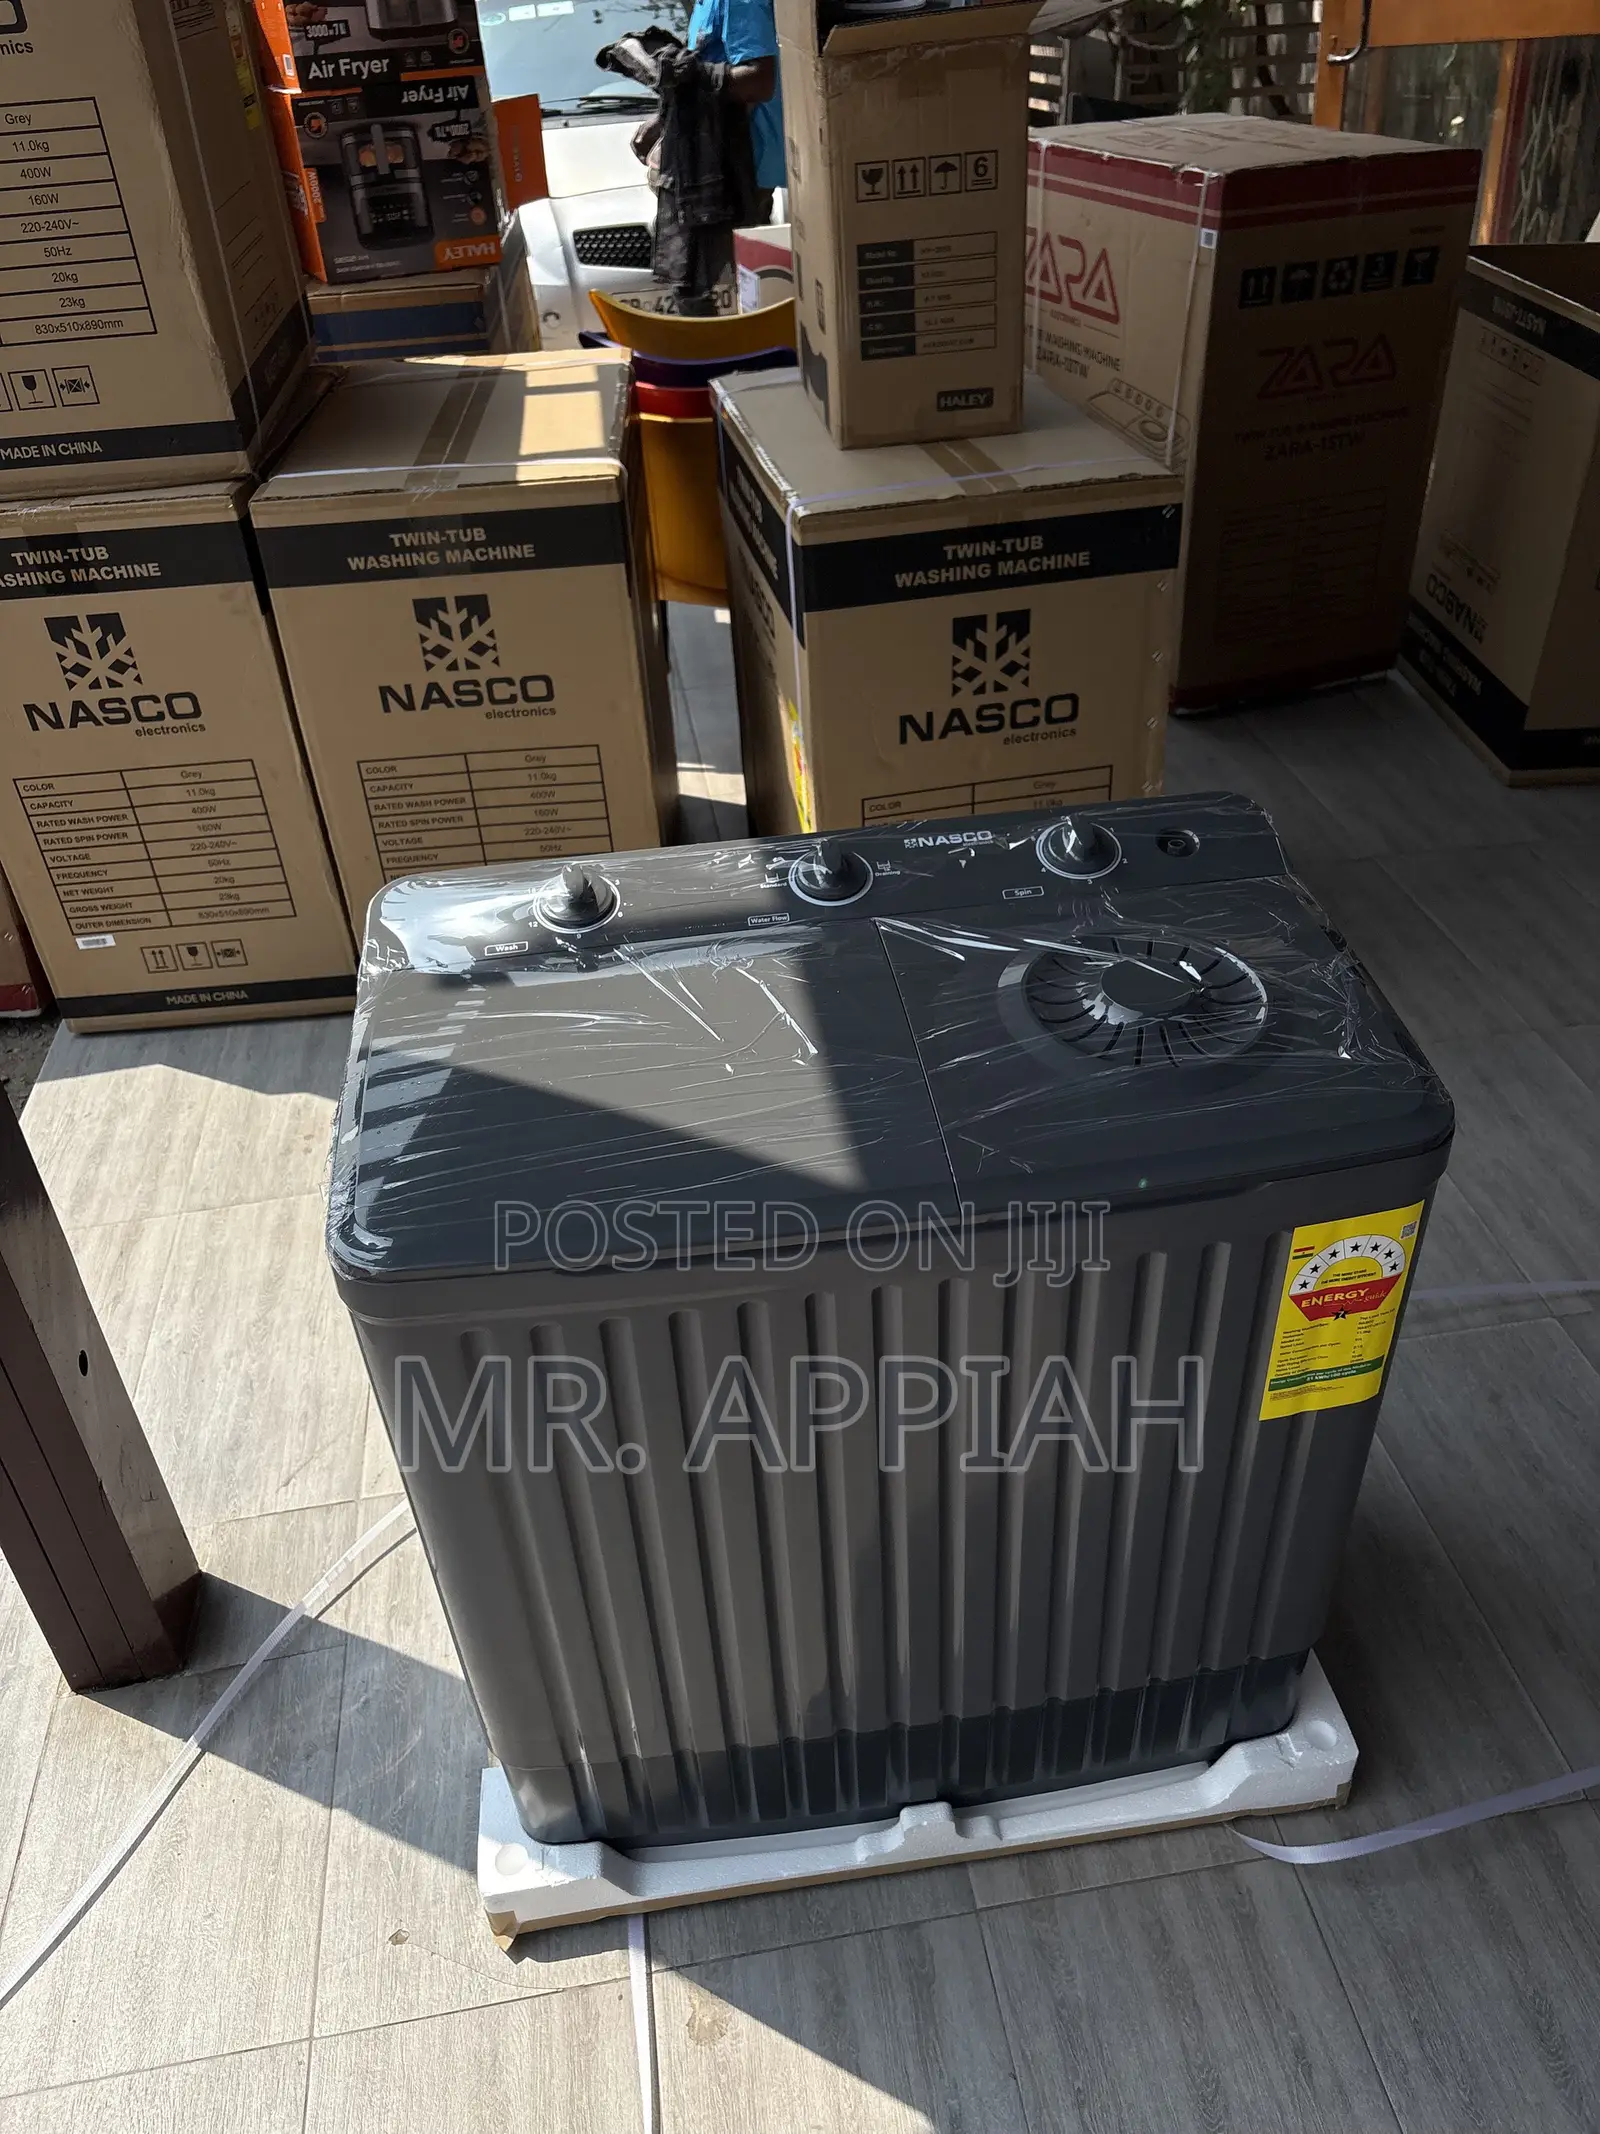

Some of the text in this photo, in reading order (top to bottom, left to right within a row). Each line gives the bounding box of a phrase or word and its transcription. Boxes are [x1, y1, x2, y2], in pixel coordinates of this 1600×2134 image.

[308, 58, 390, 80] Air Fryer
[402, 84, 469, 104] Air Fryer
[4, 113, 32, 126] Grey
[12, 139, 50, 153] 11.0kg
[20, 166, 52, 179] 400W
[974, 156, 988, 178] 6
[28, 193, 59, 206] 160W
[20, 219, 80, 233] 220-240V~
[43, 246, 72, 258] 50Hz
[443, 241, 496, 261] HALEY
[51, 272, 79, 283] 20kg
[59, 297, 86, 309] 23kg
[35, 319, 124, 335] 830x510x890mm
[1257, 333, 1397, 400] ZARA
[939, 393, 988, 408] HALEY
[0, 440, 103, 460] MADE IN CHINA
[388, 527, 487, 549] TWIN-TUB
[943, 535, 1044, 560] TWIN-TUB
[11, 546, 110, 566] TWIN-TUB
[347, 544, 536, 571] WASHING MACHINE
[70, 562, 162, 583] MACHINE
[894, 551, 1091, 588] WASHING MACHINE
[378, 674, 555, 713] NASCO
[22, 690, 203, 732] NASCO
[485, 706, 557, 720] electronics
[899, 692, 1080, 745] NASCO
[134, 721, 206, 738] electronics
[1003, 726, 1077, 746] electronics
[365, 765, 398, 775] COLOR
[23, 770, 203, 793] COLOR Grey
[369, 783, 414, 793] CAPACITY
[30, 800, 73, 811] CAPACITY
[374, 802, 404, 812] RATED
[434, 797, 466, 806] POWER
[869, 800, 902, 812] COLOR
[36, 805, 217, 829] RATED WASH POWER 400W
[378, 819, 408, 829] RATED
[431, 815, 464, 825] POWER
[43, 835, 73, 846] RATED
[74, 834, 96, 844] SPIN
[96, 831, 129, 841] POWER
[918, 830, 993, 848] NASCO
[50, 853, 91, 863] VOLTAGE
[56, 869, 108, 881] FREQUENCY
[62, 888, 80, 897] NET
[81, 885, 115, 895] WEIGHT
[1014, 888, 1033, 898] Spin
[69, 904, 99, 914] GROSS
[100, 902, 133, 911] WEIGHT
[75, 920, 105, 930] OUTER
[750, 914, 788, 924] Water Flow
[495, 944, 519, 953] Wash
[166, 989, 249, 1006] MADE IN CHINA
[1301, 1288, 1370, 1308] ENERGY
